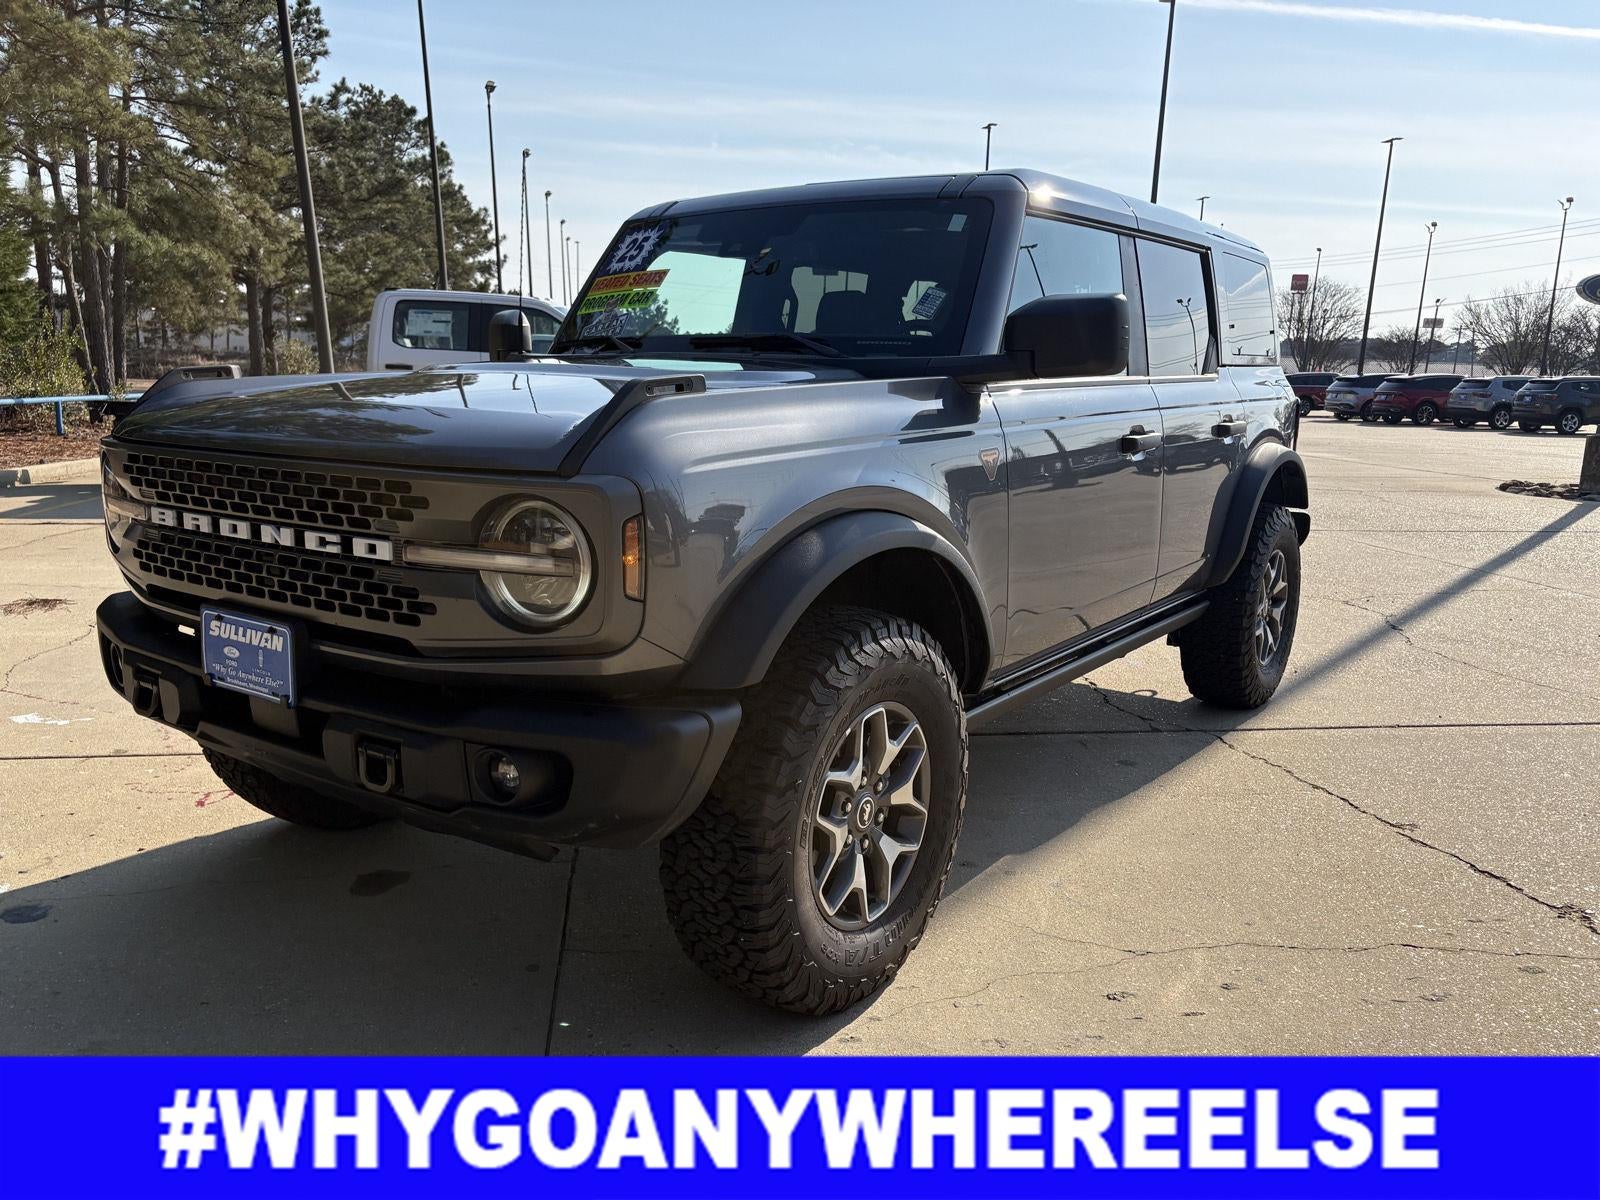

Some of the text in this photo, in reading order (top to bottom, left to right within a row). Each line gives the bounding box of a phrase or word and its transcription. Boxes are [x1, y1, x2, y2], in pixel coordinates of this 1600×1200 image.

[617, 235, 650, 263] 25
[592, 270, 667, 292] HEATED SEATS
[627, 290, 655, 305] CAR
[151, 506, 394, 562] BRONCO
[209, 619, 283, 652] SULLIVAN
[228, 667, 237, 676] Go
[238, 670, 265, 684] Anywhere
